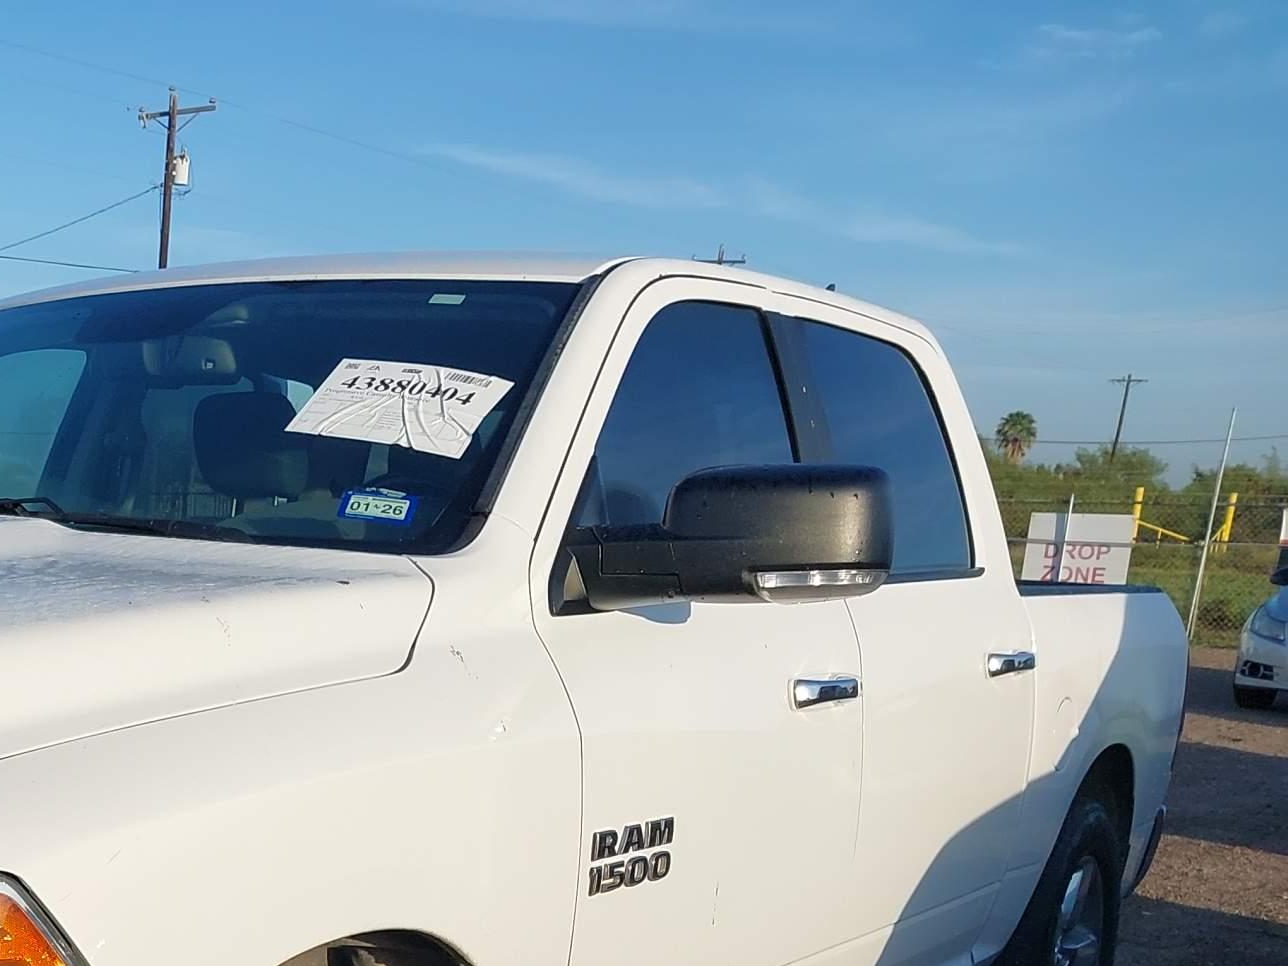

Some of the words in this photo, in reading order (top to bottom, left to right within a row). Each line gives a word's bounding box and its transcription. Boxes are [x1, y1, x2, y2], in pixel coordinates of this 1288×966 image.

[341, 375, 476, 405] 43880404
[1043, 542, 1111, 560] DROP
[1040, 565, 1107, 584] ZONE
[591, 816, 674, 862] RAM
[588, 850, 671, 897] 1500
